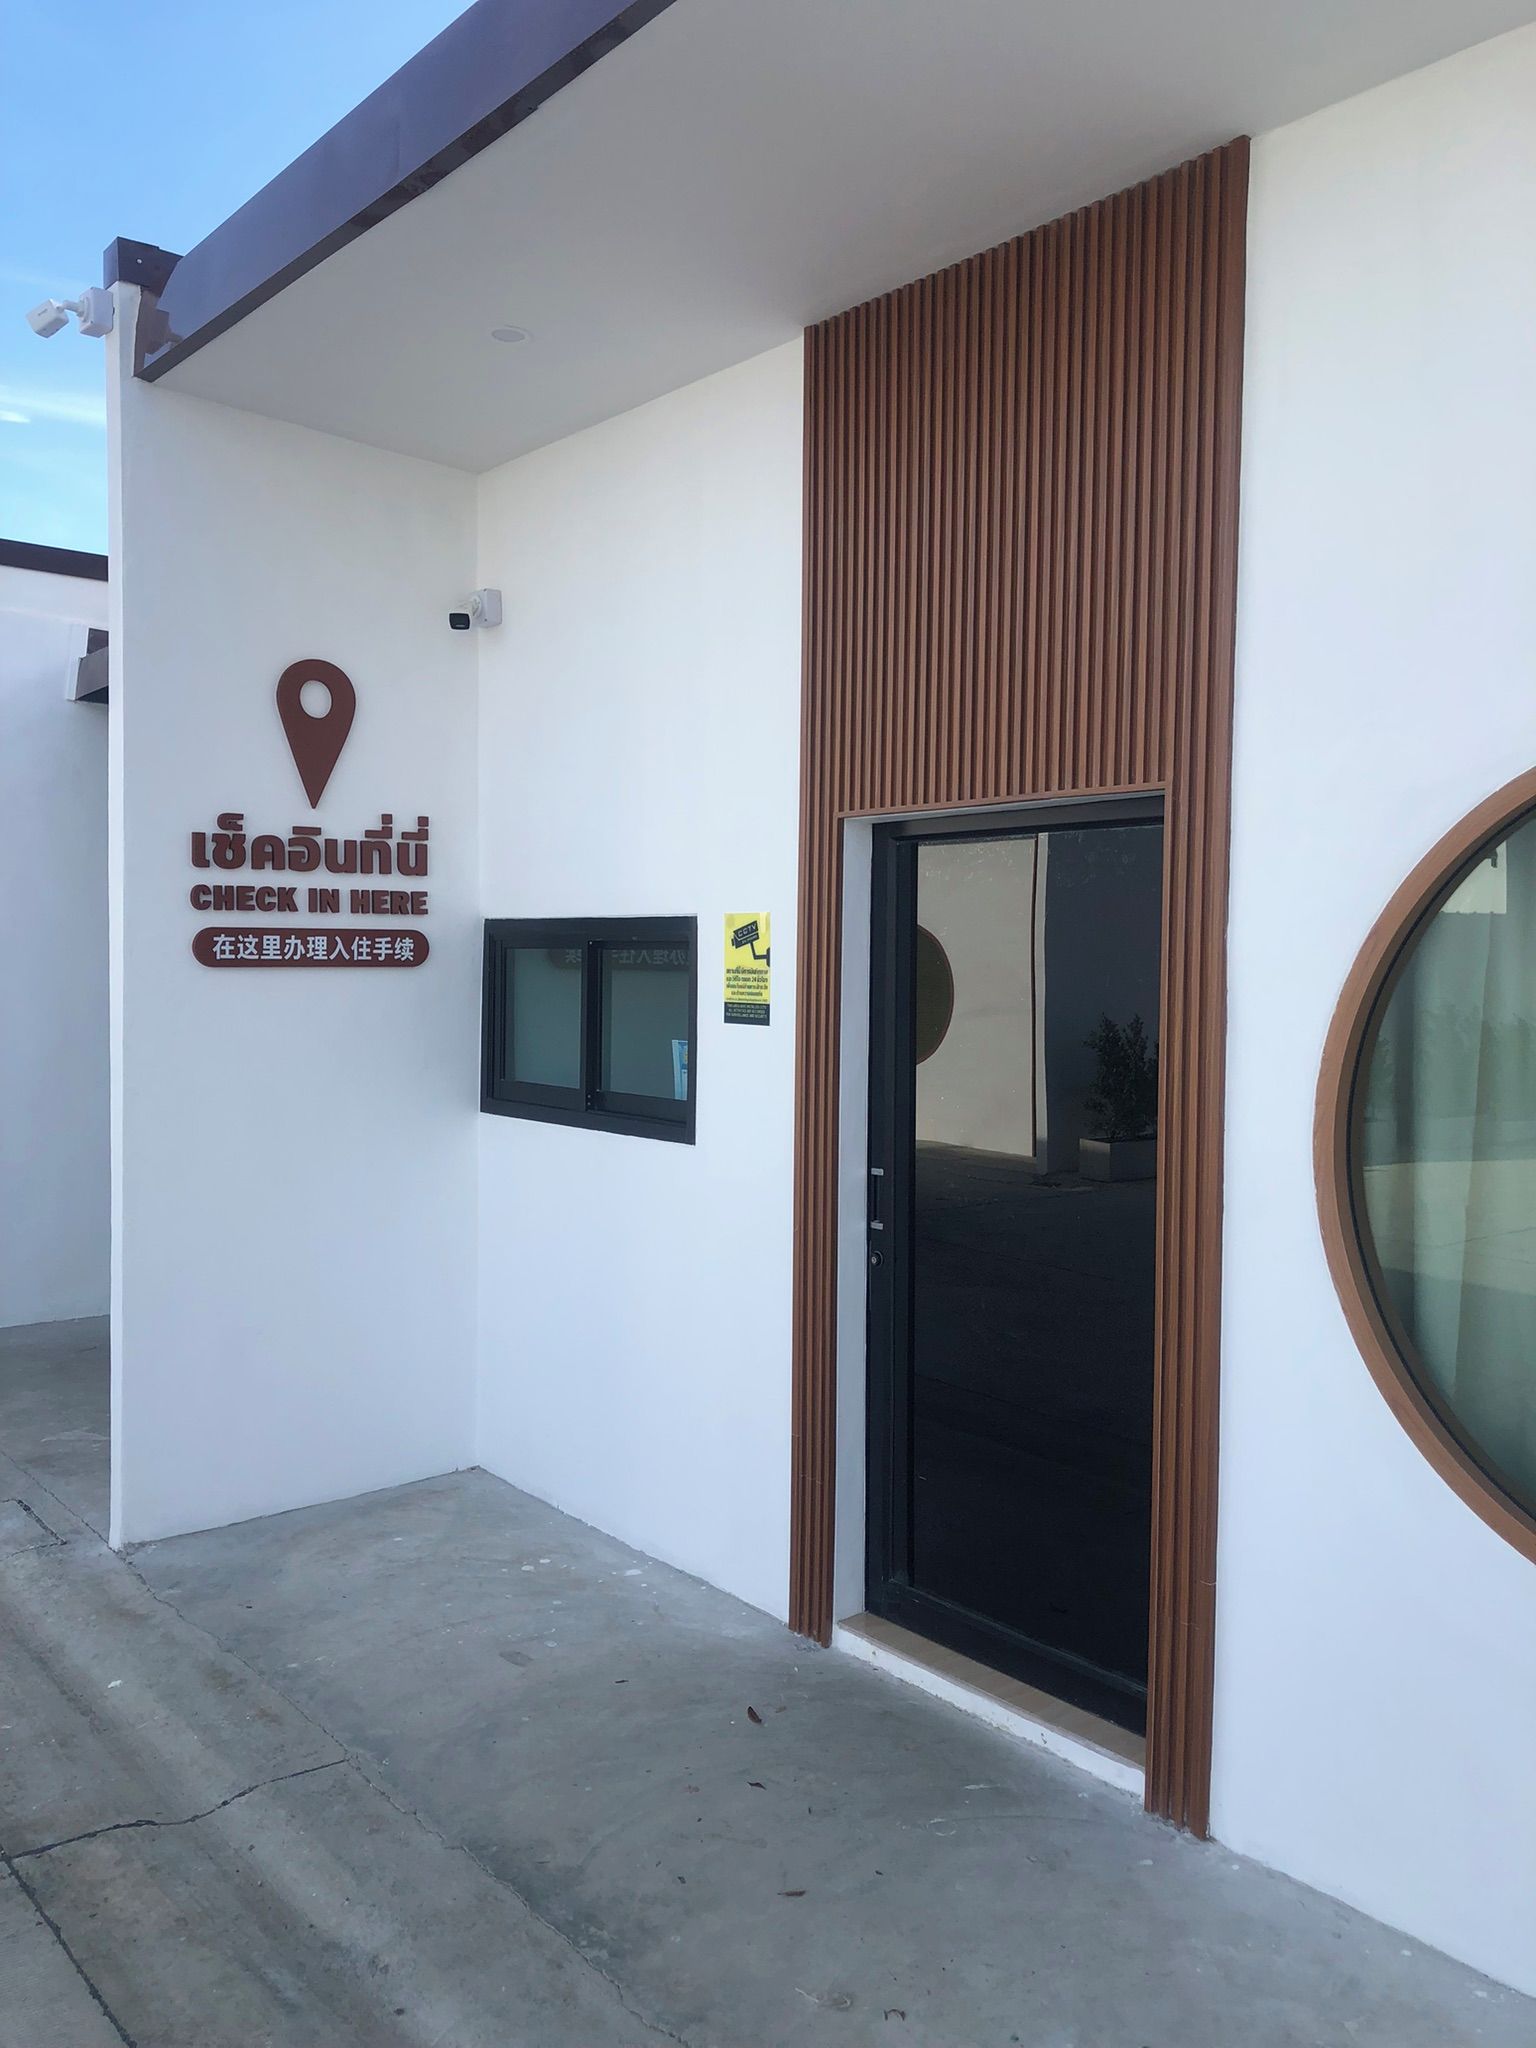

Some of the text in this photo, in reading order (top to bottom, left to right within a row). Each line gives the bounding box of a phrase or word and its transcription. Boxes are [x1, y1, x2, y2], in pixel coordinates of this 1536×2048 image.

[191, 812, 429, 876] เช็คอินที่นี่
[190, 884, 428, 915] CHECK IN HERE
[737, 923, 757, 937] CCTV
[212, 933, 414, 962] 在这里办理入住手续
